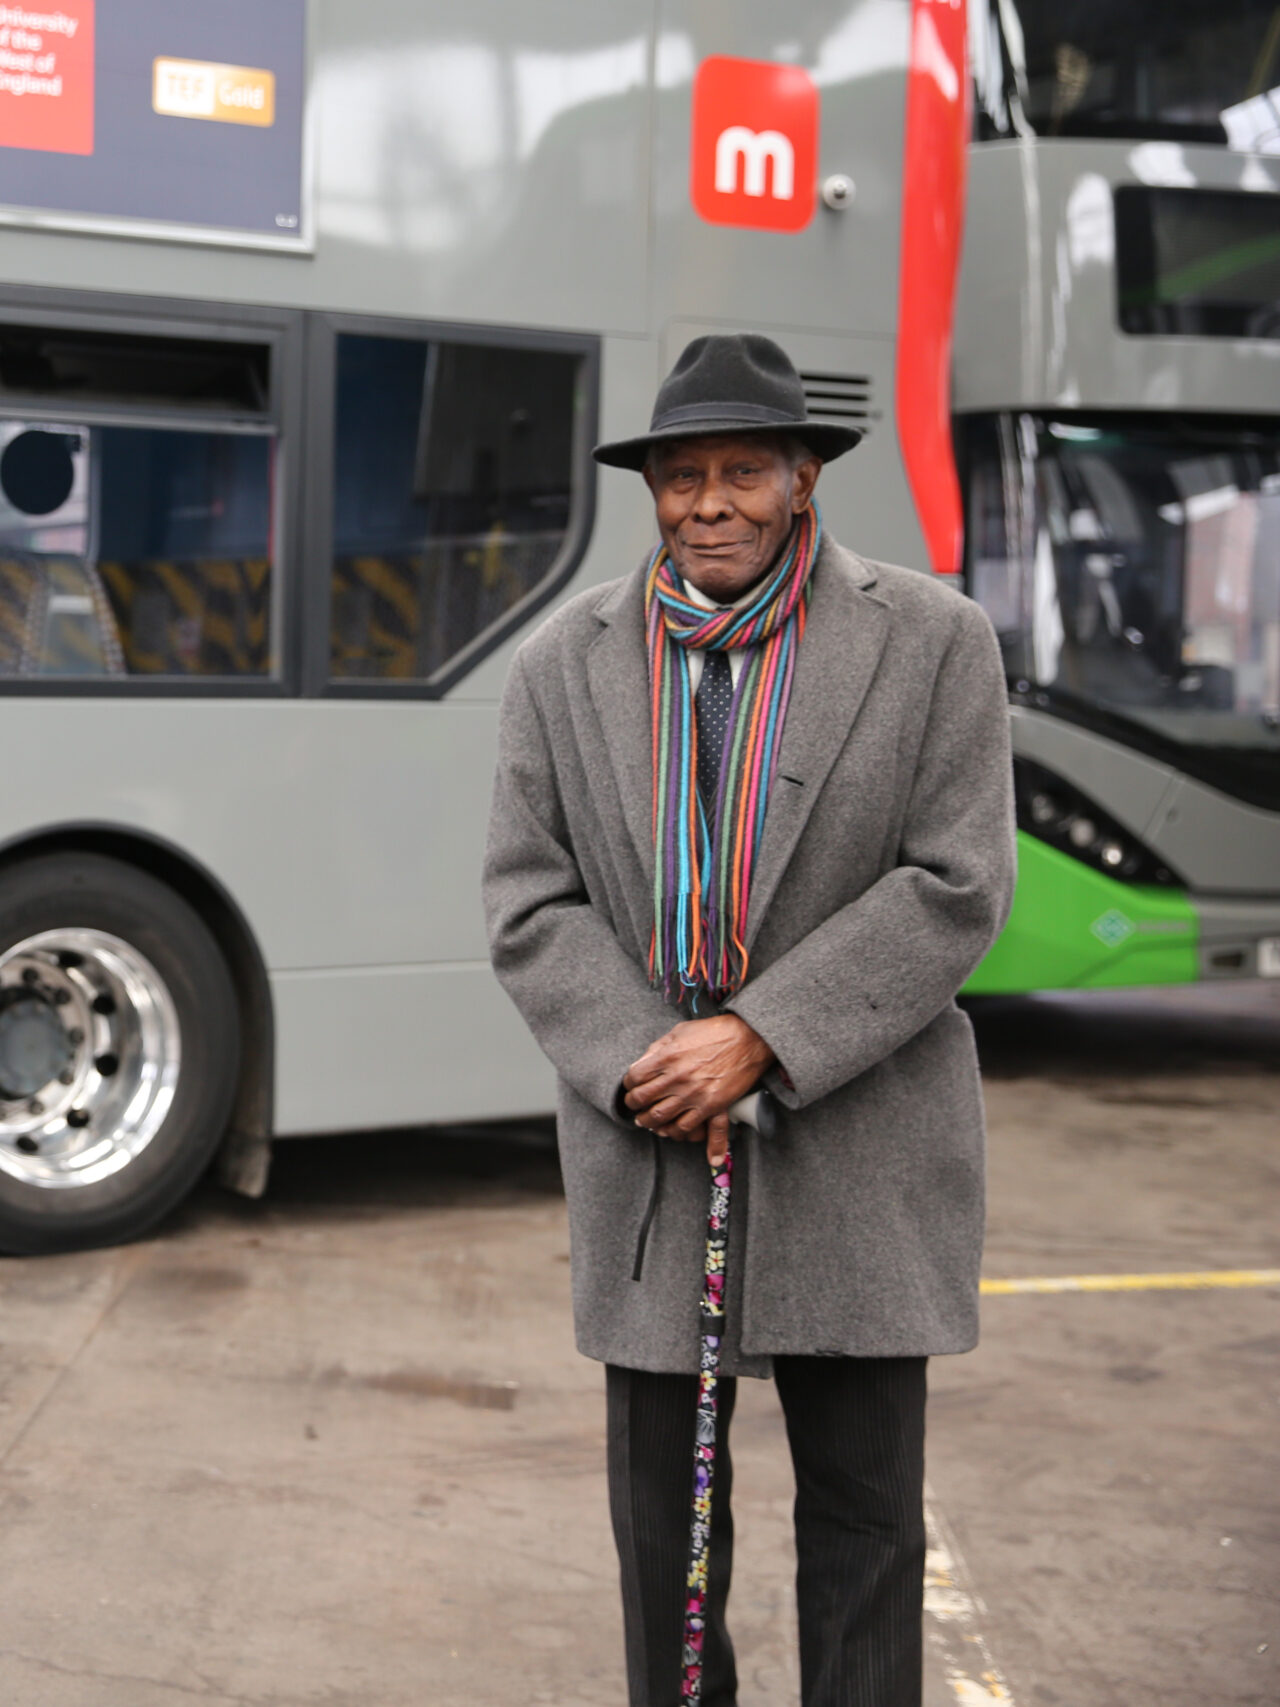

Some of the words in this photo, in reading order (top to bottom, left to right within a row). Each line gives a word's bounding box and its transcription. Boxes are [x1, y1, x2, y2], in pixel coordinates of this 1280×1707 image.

[11, 28, 43, 52] the
[35, 52, 56, 75] of
[715, 125, 795, 201] m
